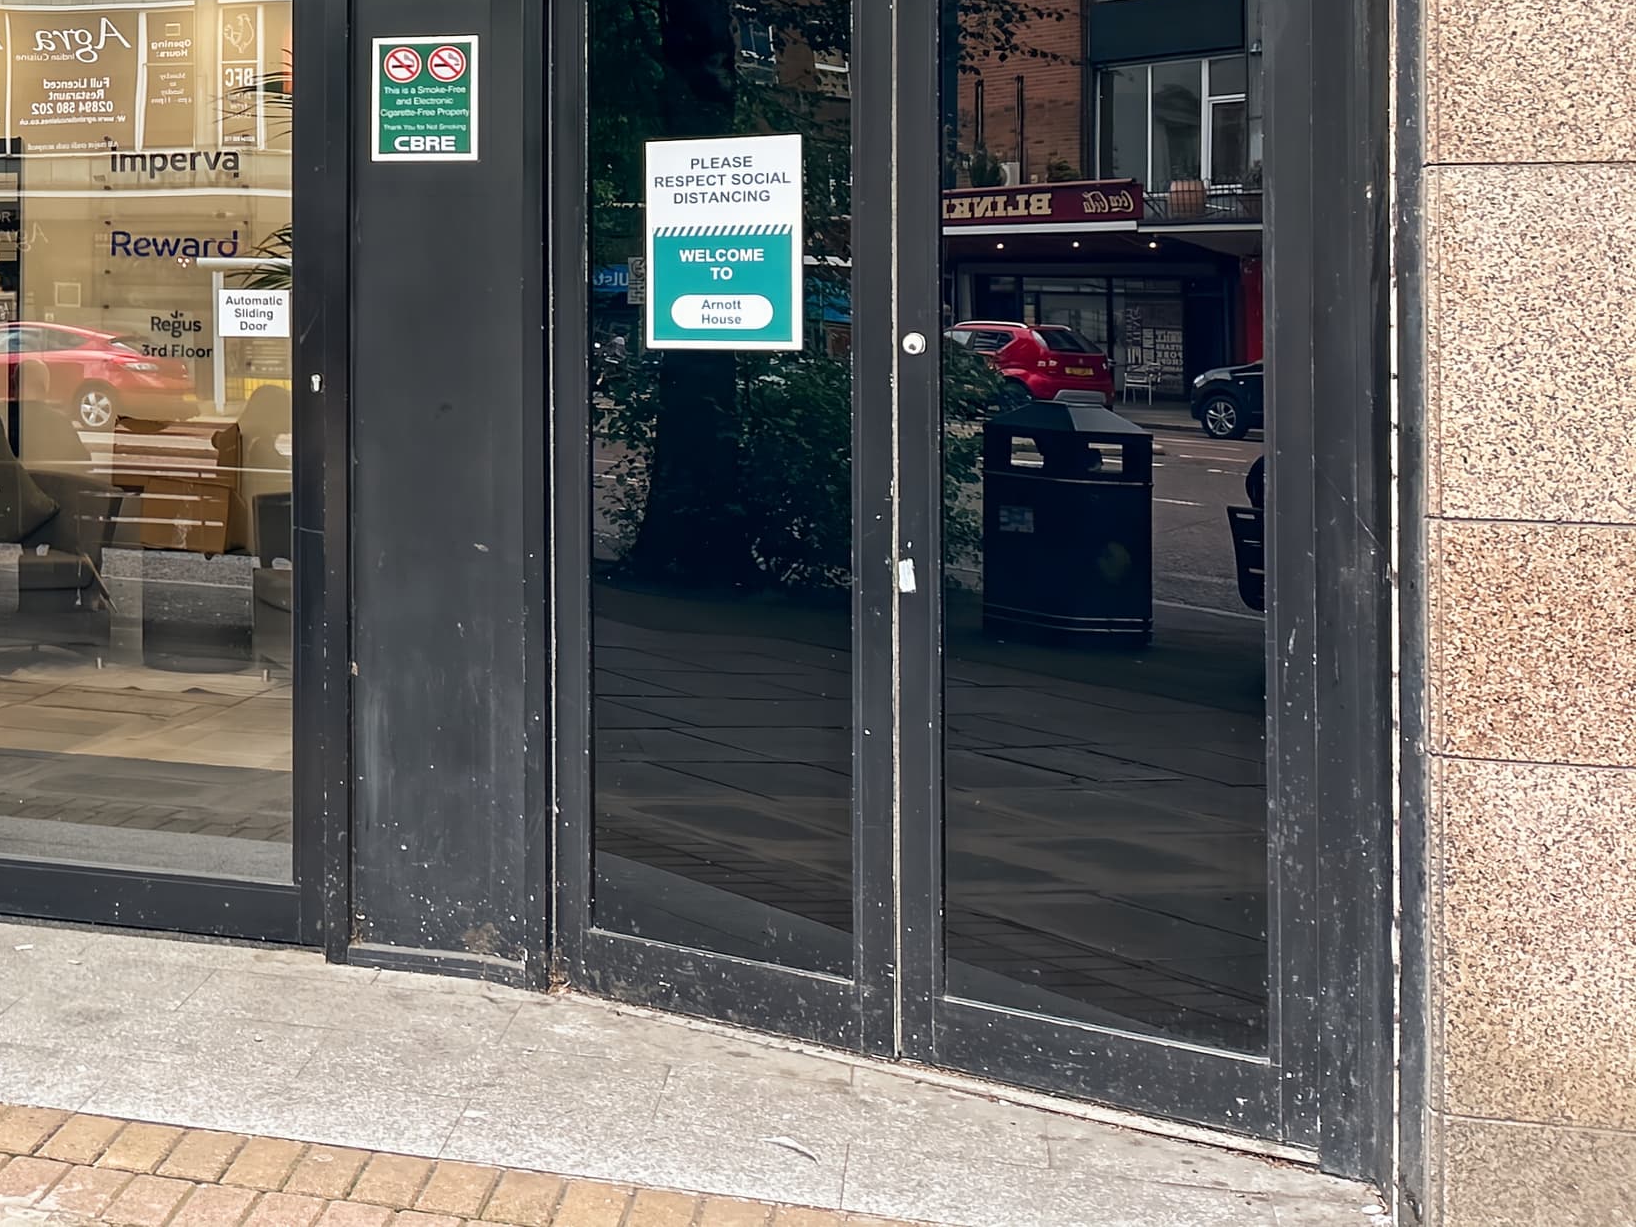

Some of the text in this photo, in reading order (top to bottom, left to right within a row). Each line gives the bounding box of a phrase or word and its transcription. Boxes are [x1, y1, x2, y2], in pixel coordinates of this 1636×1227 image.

[384, 86, 400, 95] This
[417, 85, 467, 94] Smoke-Free
[396, 96, 454, 105] and Electronic
[436, 107, 469, 117] Property
[394, 135, 456, 151] CBRE
[110, 148, 240, 179] imperva
[690, 155, 753, 170] PLEASE
[654, 171, 791, 189] RESPECT SOCIAL
[673, 189, 771, 205] DISTANCING
[111, 230, 239, 258] Reward
[679, 248, 765, 263] WELCOME
[710, 266, 733, 281] TO
[225, 295, 283, 307] Automatic
[701, 299, 742, 310] Arnott
[234, 308, 274, 321] Sliding
[701, 313, 742, 325] House
[150, 316, 202, 338] Regus
[239, 321, 268, 332] Door
[141, 343, 213, 358] 3rd Floor
